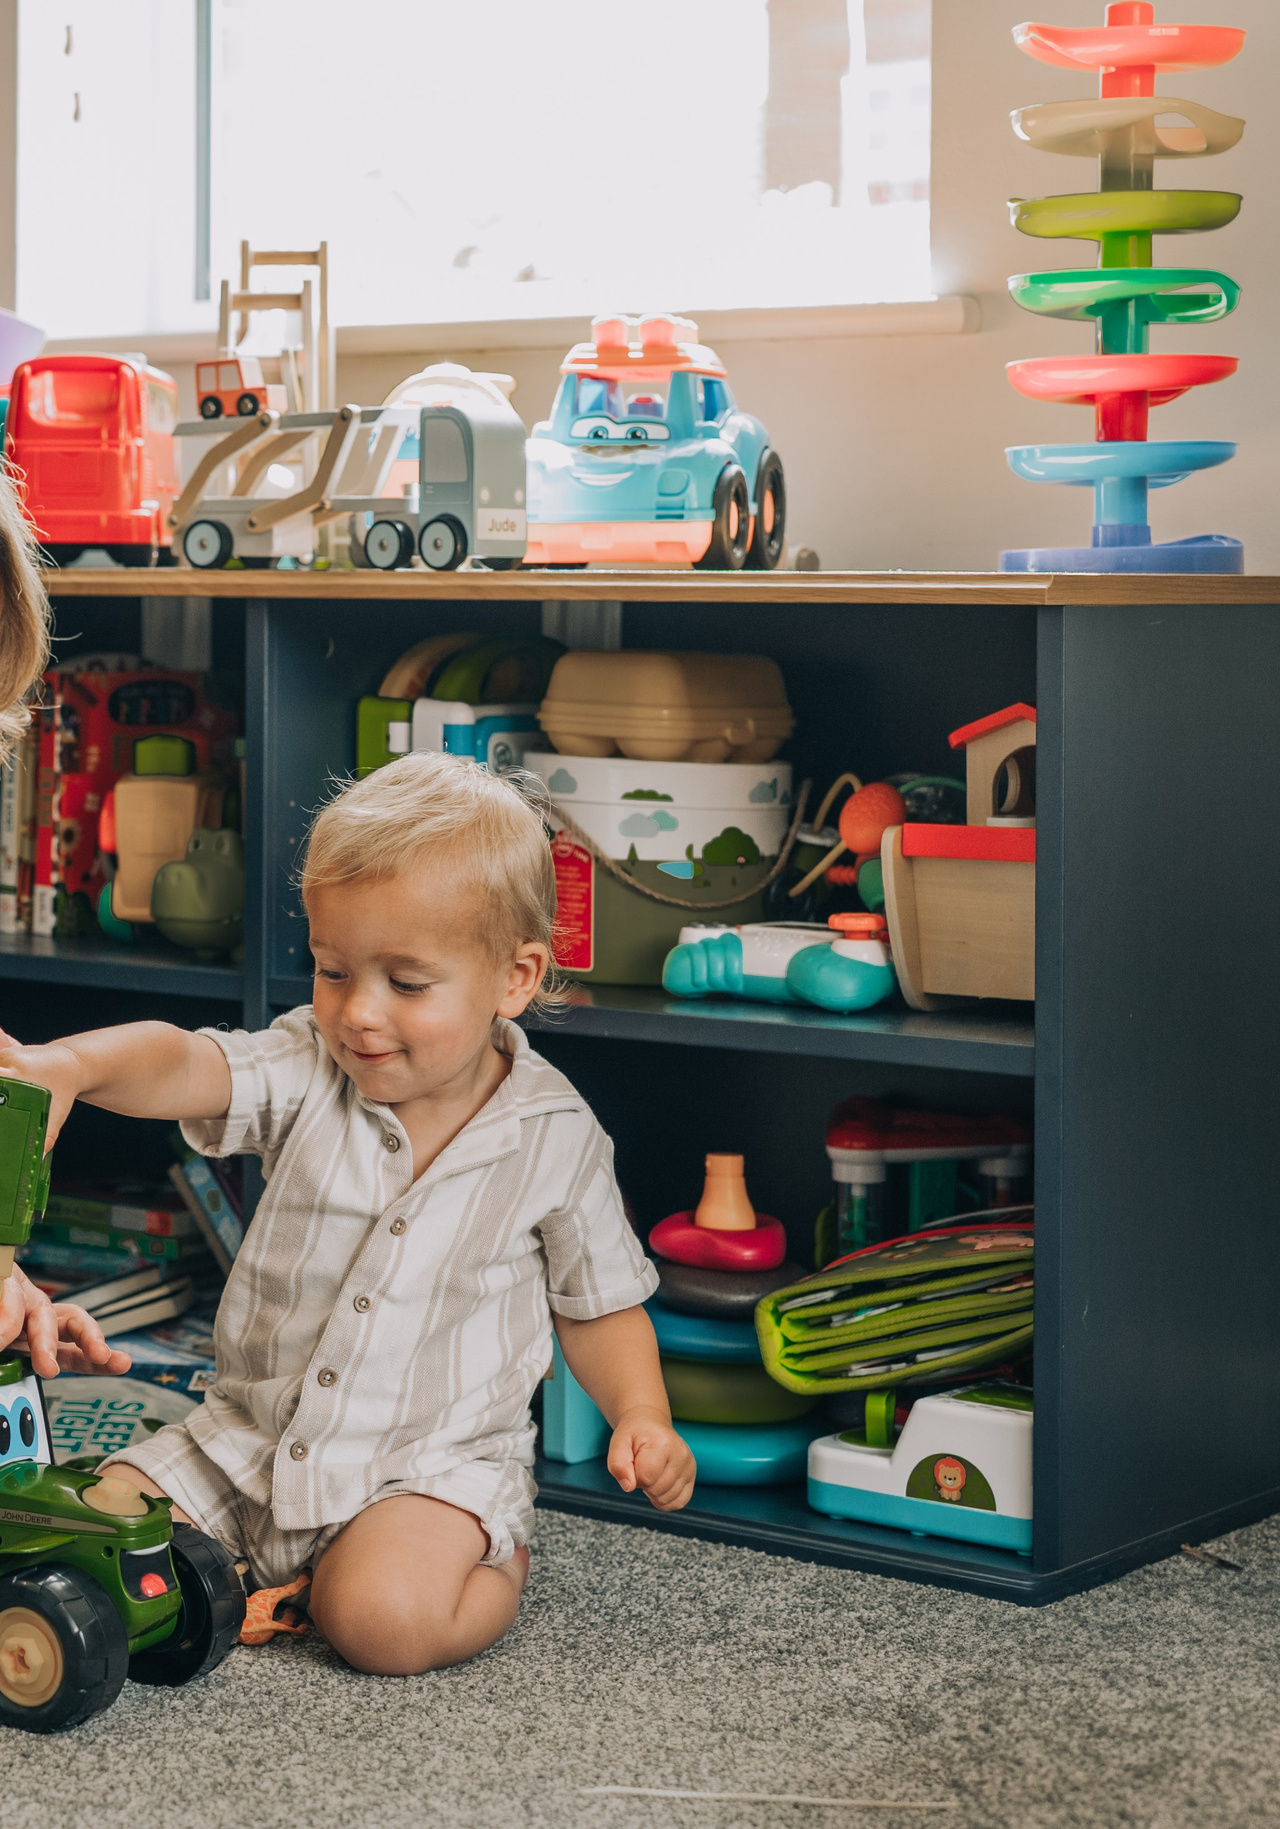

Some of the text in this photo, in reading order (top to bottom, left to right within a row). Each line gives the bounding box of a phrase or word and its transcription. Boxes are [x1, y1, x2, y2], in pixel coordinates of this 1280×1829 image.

[488, 517, 517, 532] Jude
[51, 1398, 103, 1454] TIGHT
[89, 1400, 146, 1453] SLEEP
[1, 1510, 53, 1526] JOHN DEERE
